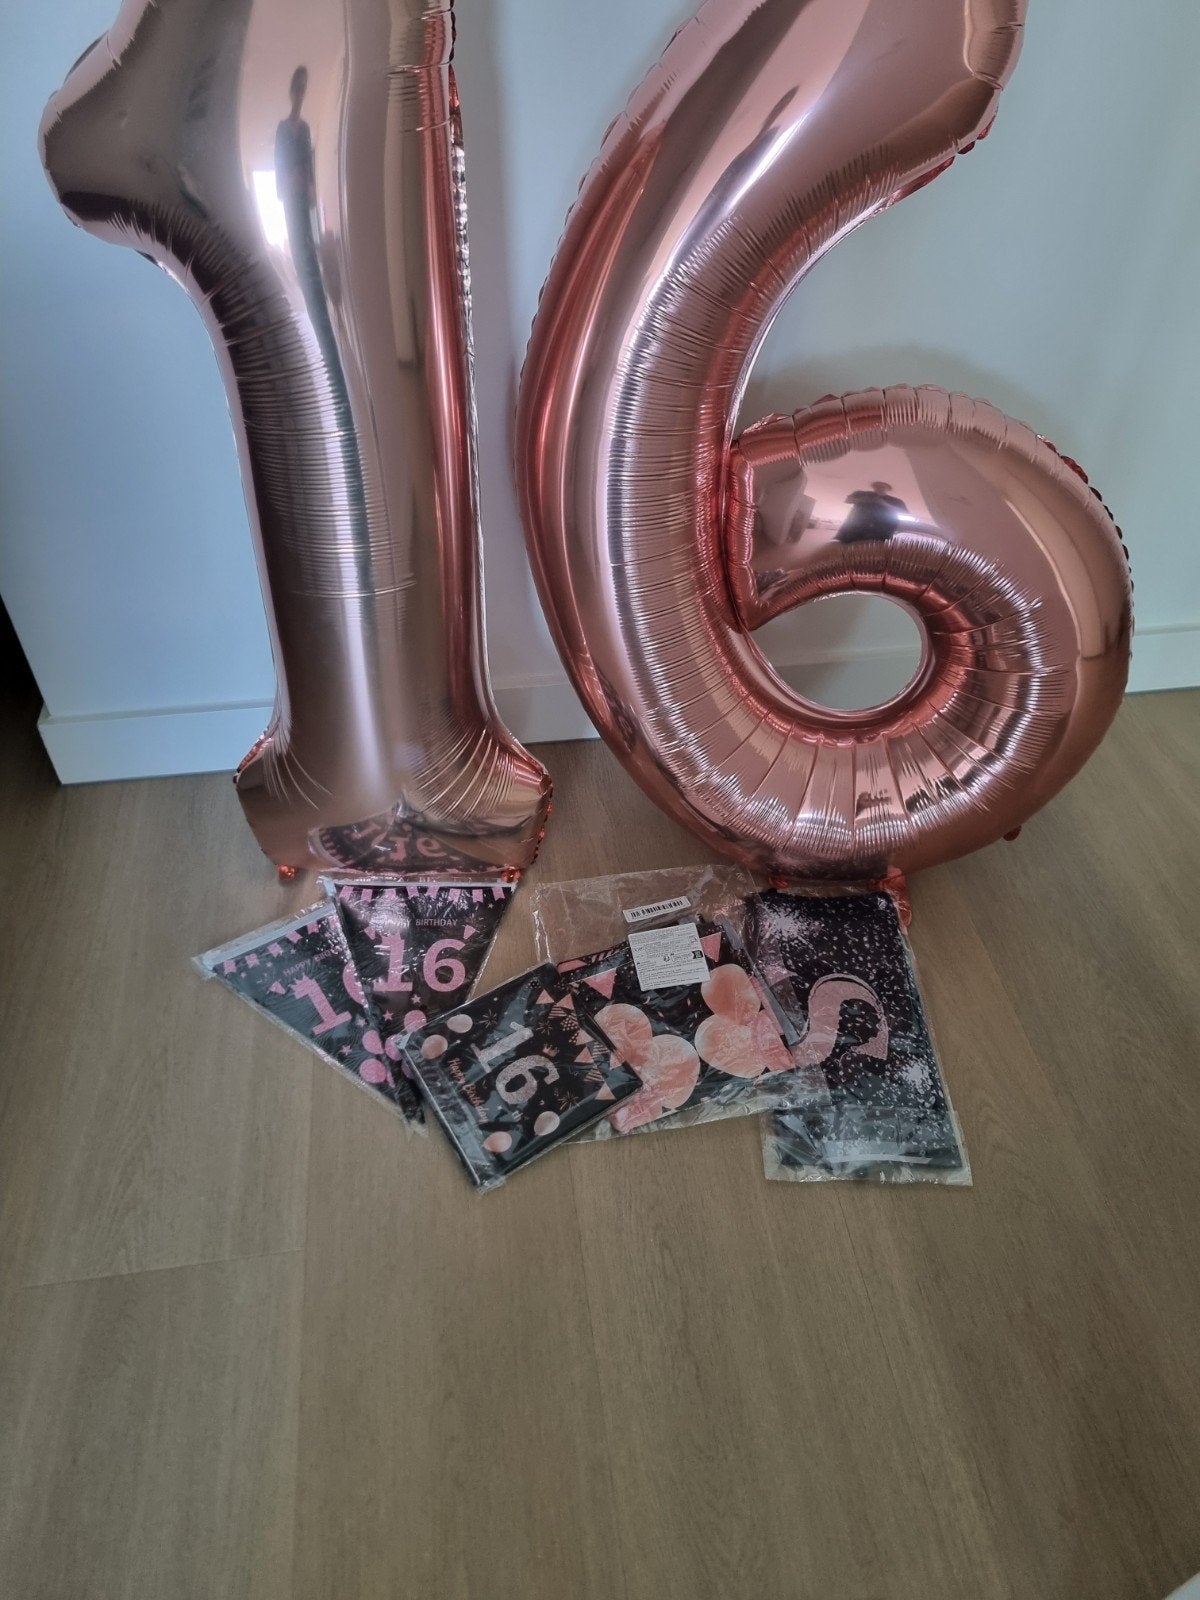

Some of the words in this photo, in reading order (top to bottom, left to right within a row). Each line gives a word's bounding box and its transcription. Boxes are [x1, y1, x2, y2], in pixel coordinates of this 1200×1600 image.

[415, 918, 458, 927] BIRTHDAY
[373, 932, 466, 992] 16
[447, 1057, 466, 1085] Happy
[461, 1083, 490, 1125] Birthday
